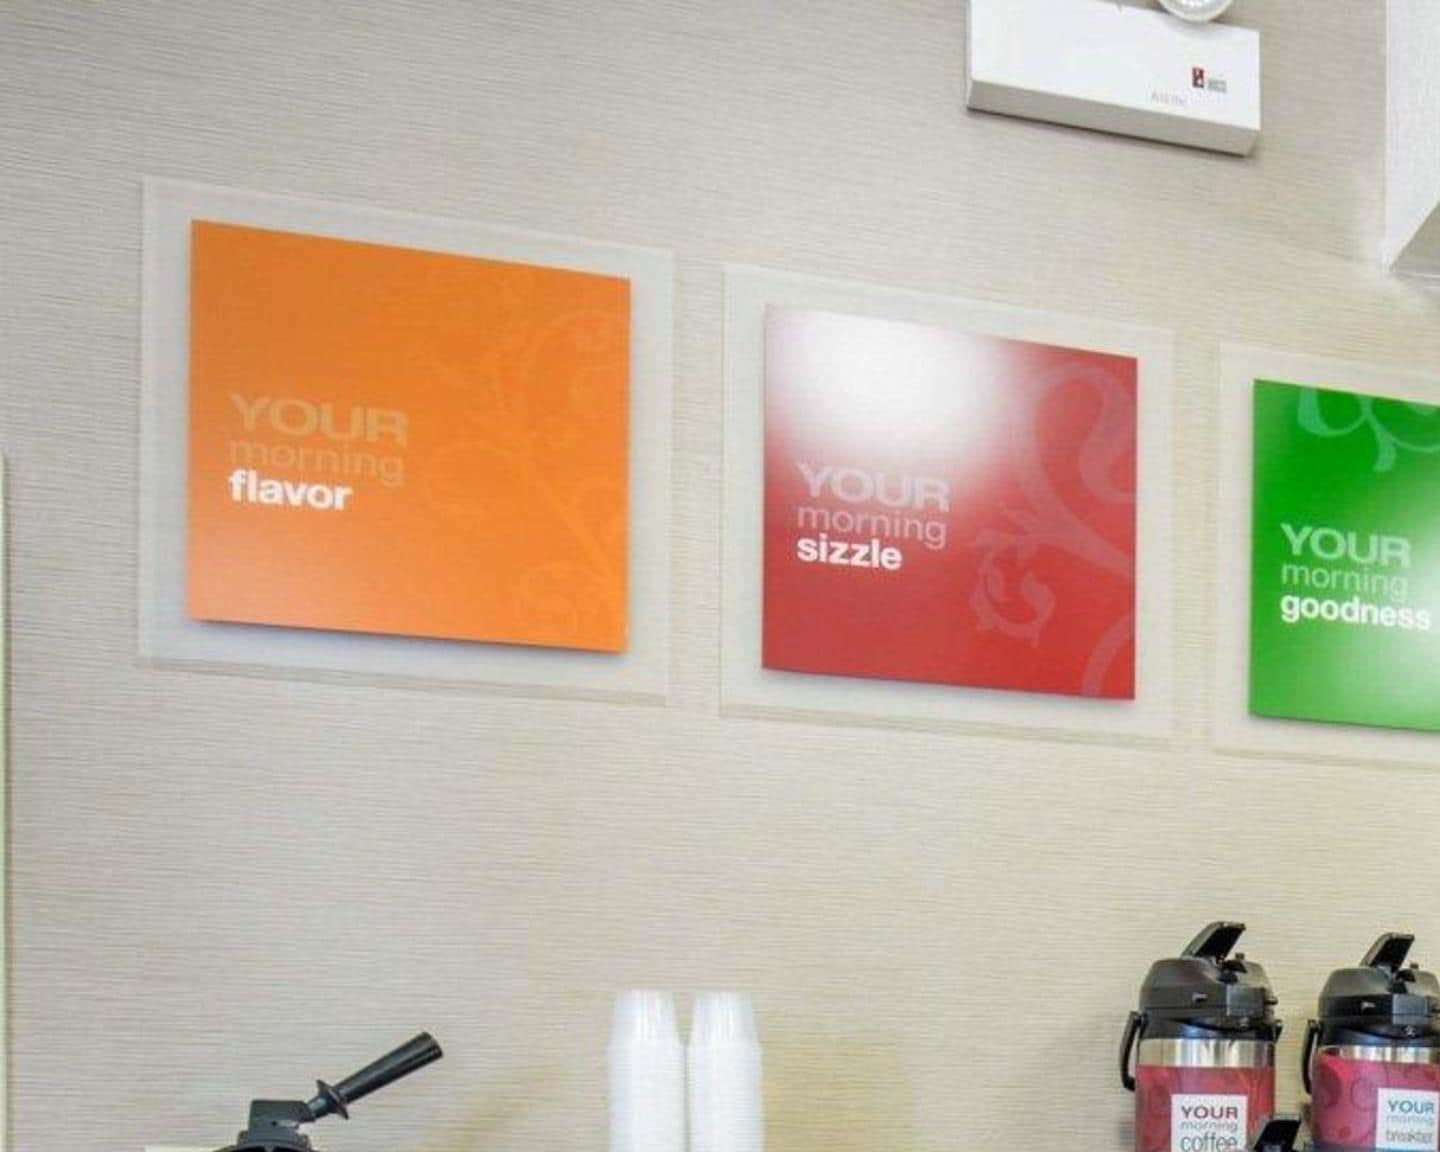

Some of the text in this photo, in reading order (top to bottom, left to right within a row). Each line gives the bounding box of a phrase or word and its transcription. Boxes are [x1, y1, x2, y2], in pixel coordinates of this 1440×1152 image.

[228, 393, 408, 446] YOUR
[230, 441, 405, 487] morning
[229, 469, 353, 511] flavor
[796, 463, 950, 512] YOUR
[797, 506, 947, 550] morning
[1280, 523, 1412, 568] YOUR
[797, 533, 903, 571] sizzle
[1281, 564, 1408, 603] morning
[1280, 594, 1433, 631] goodness
[1181, 1105, 1239, 1119] YOUR
[1387, 1099, 1435, 1114] YOUR
[1180, 1120, 1239, 1133] morning
[1180, 1132, 1238, 1152] coffee
